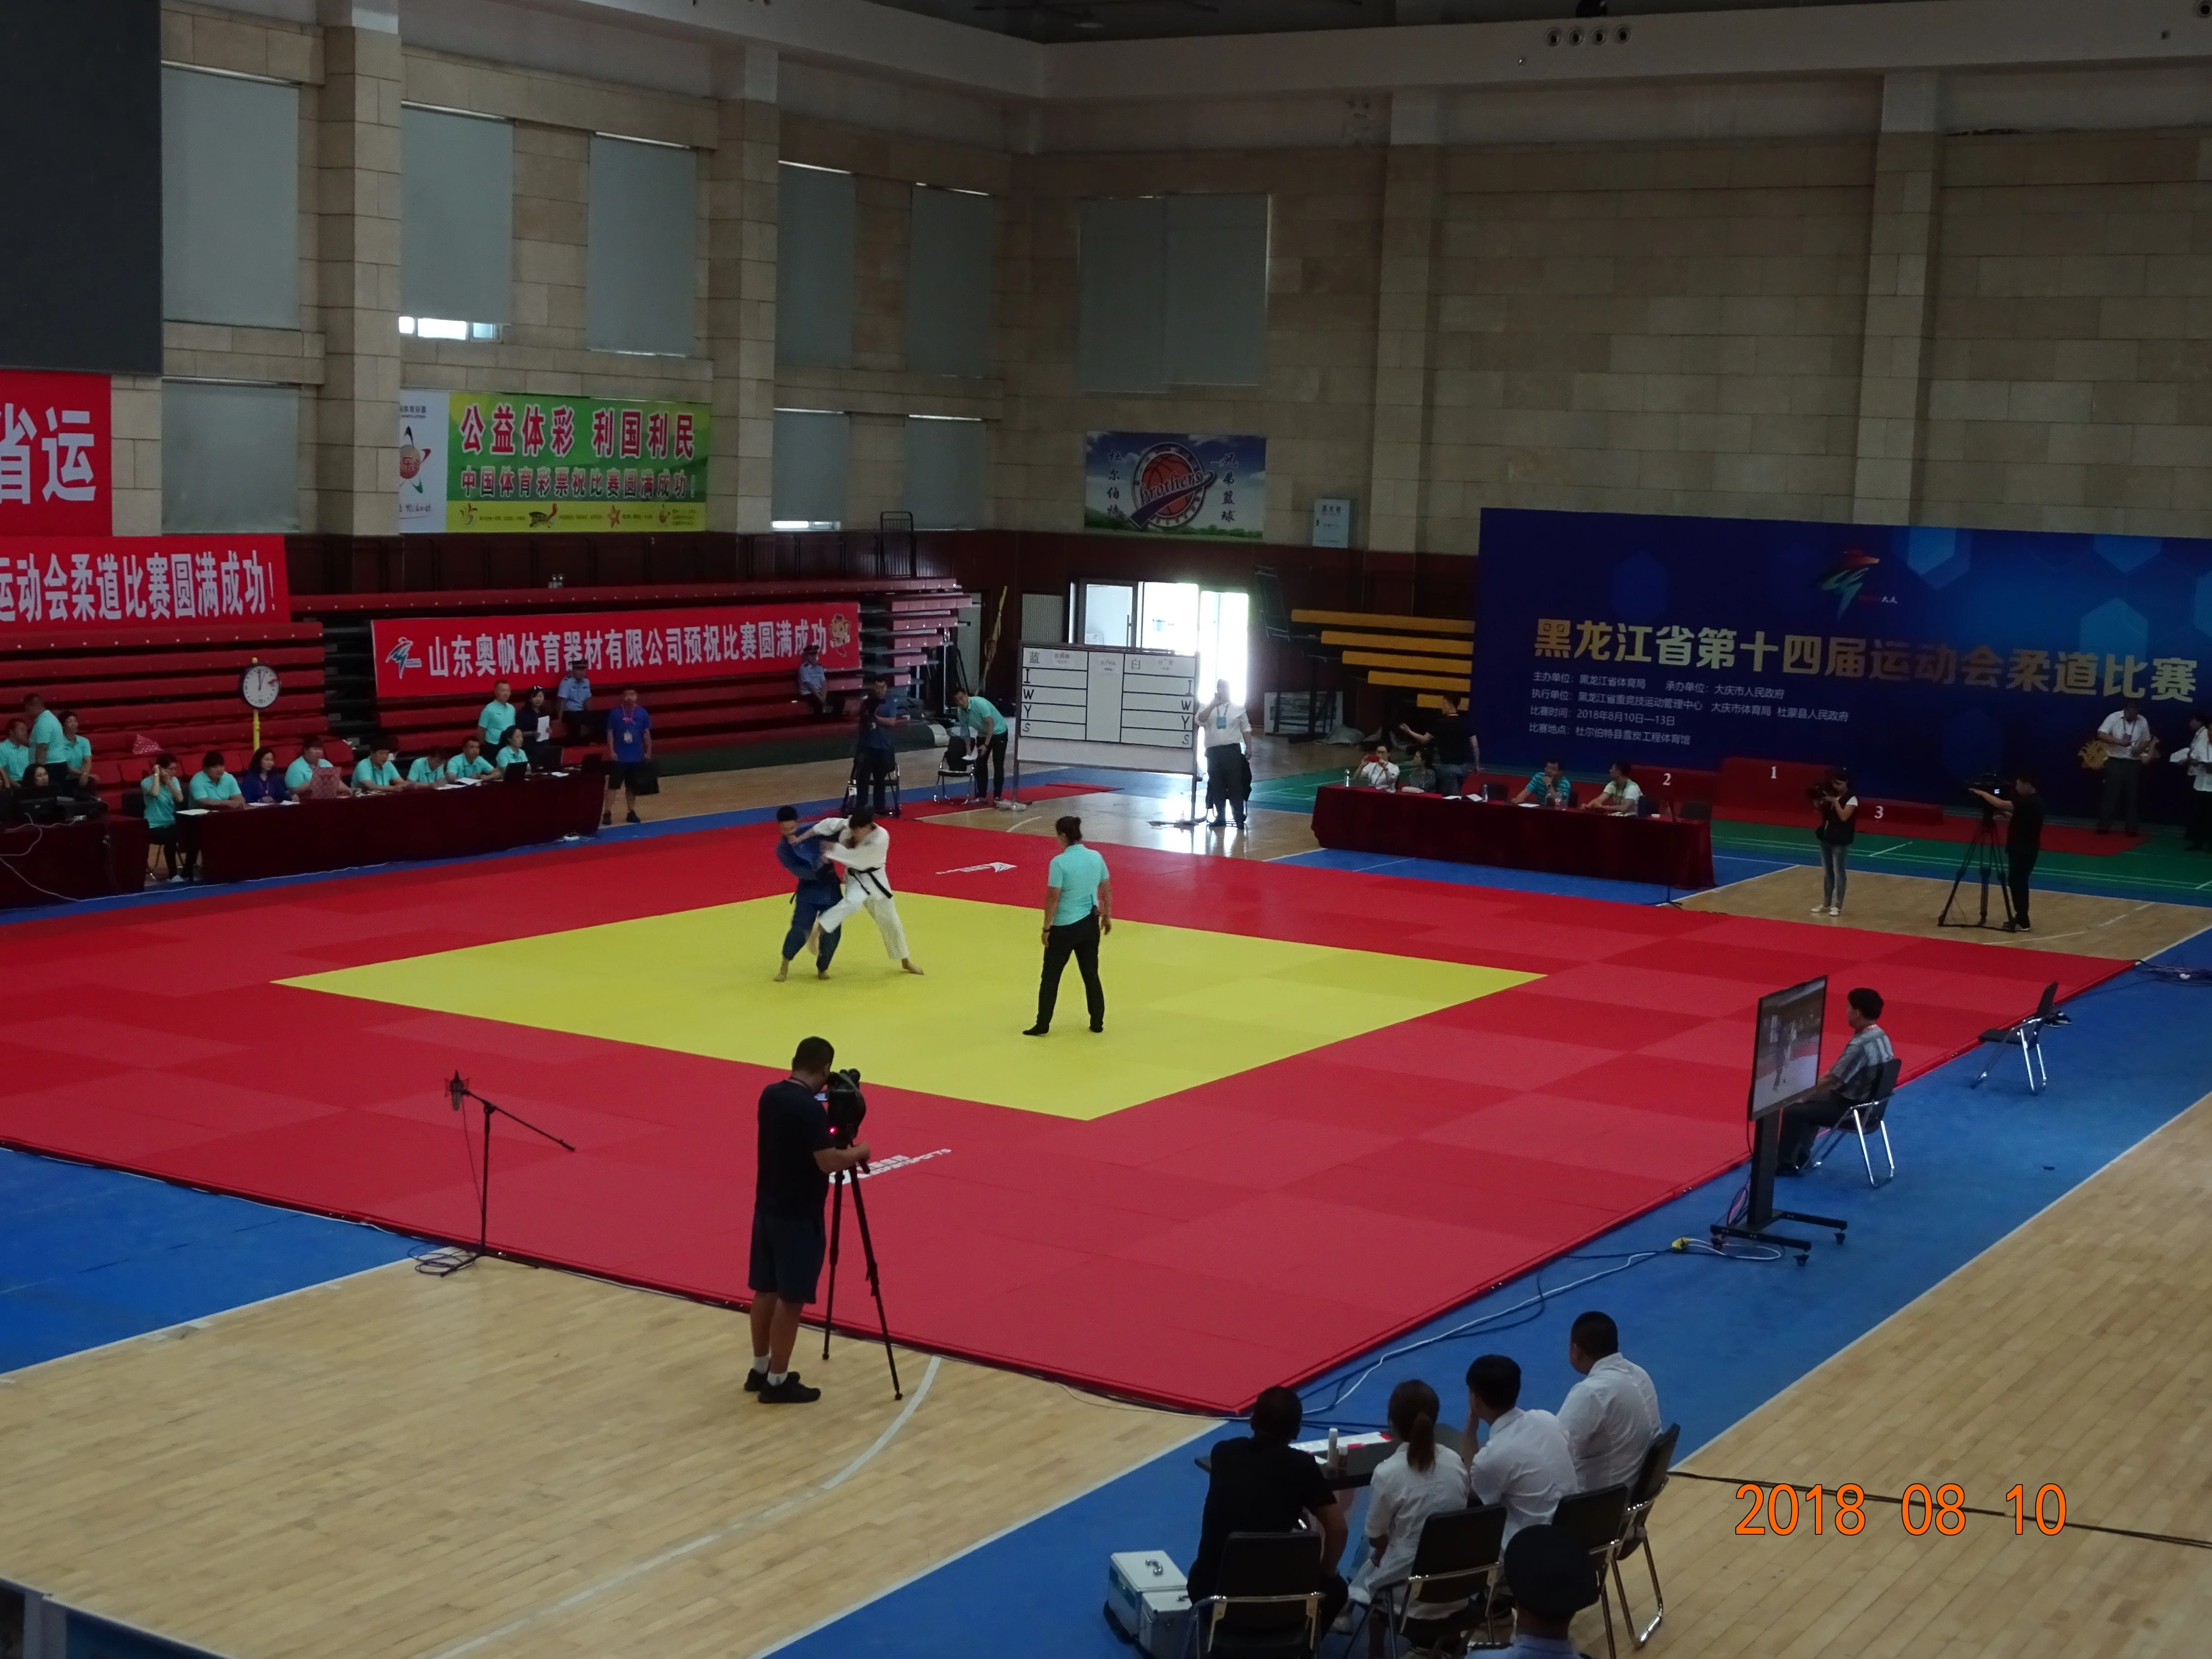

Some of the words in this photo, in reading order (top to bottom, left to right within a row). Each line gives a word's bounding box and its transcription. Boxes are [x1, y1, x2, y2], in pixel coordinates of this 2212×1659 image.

[459, 404, 574, 457] 公益体彩
[592, 408, 694, 460] 利国利民
[0, 403, 96, 504] 省运
[1139, 470, 1203, 504] brothers
[0, 550, 276, 623] 运动会柔道比赛圆满成功!
[429, 618, 827, 677] 山东奥帆体育器材有限公司预祝比赛圆满成功
[1028, 651, 1040, 664] 蓝
[1131, 658, 1141, 670] 白
[1534, 619, 2198, 703] 黑龙江省第十四届运动会柔道比赛
[1023, 689, 1034, 700] W
[1023, 704, 1031, 719] Y
[1181, 700, 1191, 711] W
[1022, 723, 1031, 732] S
[1181, 716, 1190, 730] Y
[1182, 735, 1189, 745] S
[1771, 766, 1777, 778] 1
[1663, 773, 1671, 785] 2
[1875, 806, 1884, 819] 3
